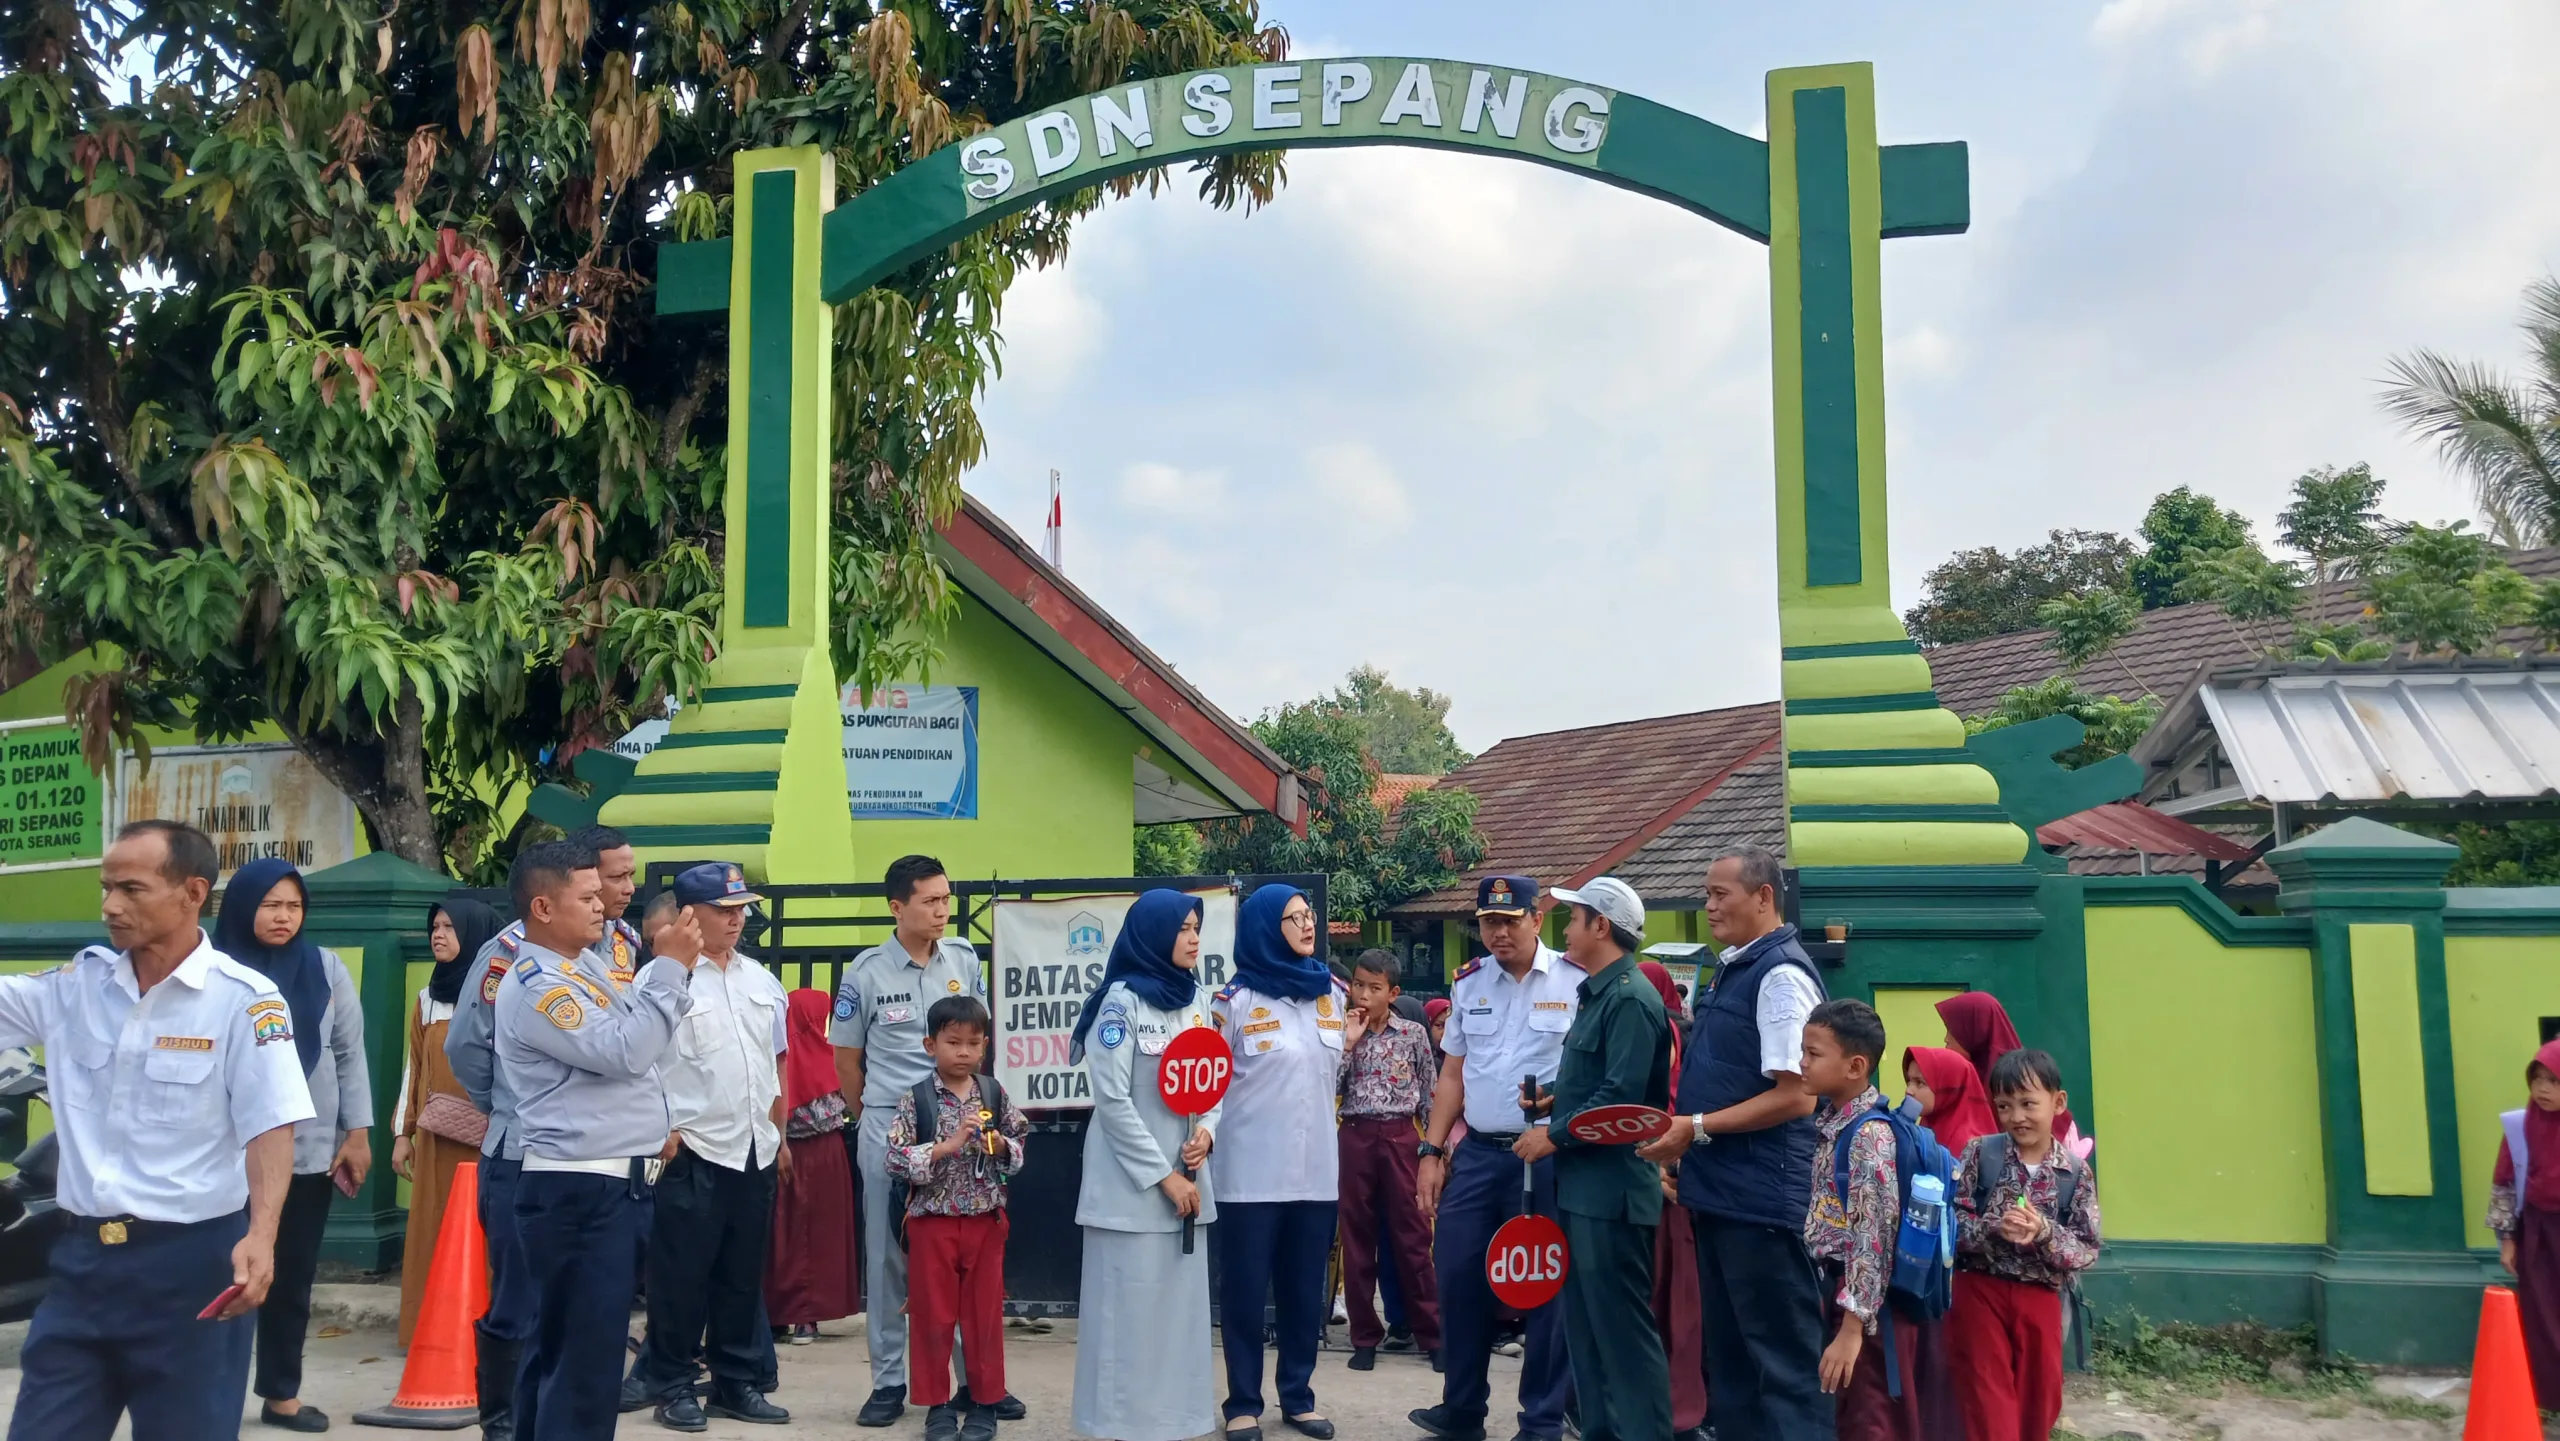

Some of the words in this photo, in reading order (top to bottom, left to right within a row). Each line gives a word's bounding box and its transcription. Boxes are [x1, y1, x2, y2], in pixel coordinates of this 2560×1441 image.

[960, 86, 1154, 199] SDN
[1181, 62, 1609, 154] SEPANG
[857, 714, 928, 729] PUNGUTAN
[930, 716, 959, 730] BAGI
[9, 739, 81, 761] PRAMUK
[842, 748, 880, 760] ATUAN
[882, 748, 953, 760] PENDIDIKAN
[12, 763, 69, 785] DEPAN
[16, 785, 86, 811] 01.120
[18, 811, 84, 832] SEPANG
[197, 805, 236, 833] TANAH
[238, 804, 271, 832] MILIK
[0, 838, 24, 852] OTA
[27, 832, 81, 849] SERANG
[1005, 963, 1104, 998] BATAS
[876, 993, 912, 1006] HARIS
[1005, 1001, 1082, 1032] JEMP
[159, 1038, 209, 1050] DISHUB
[1007, 1034, 1071, 1068] SDN
[1028, 1072, 1090, 1100] KOTA
[1164, 1056, 1228, 1095] STOP
[1575, 1113, 1662, 1142] STOP
[1490, 1243, 1562, 1283] STOP
